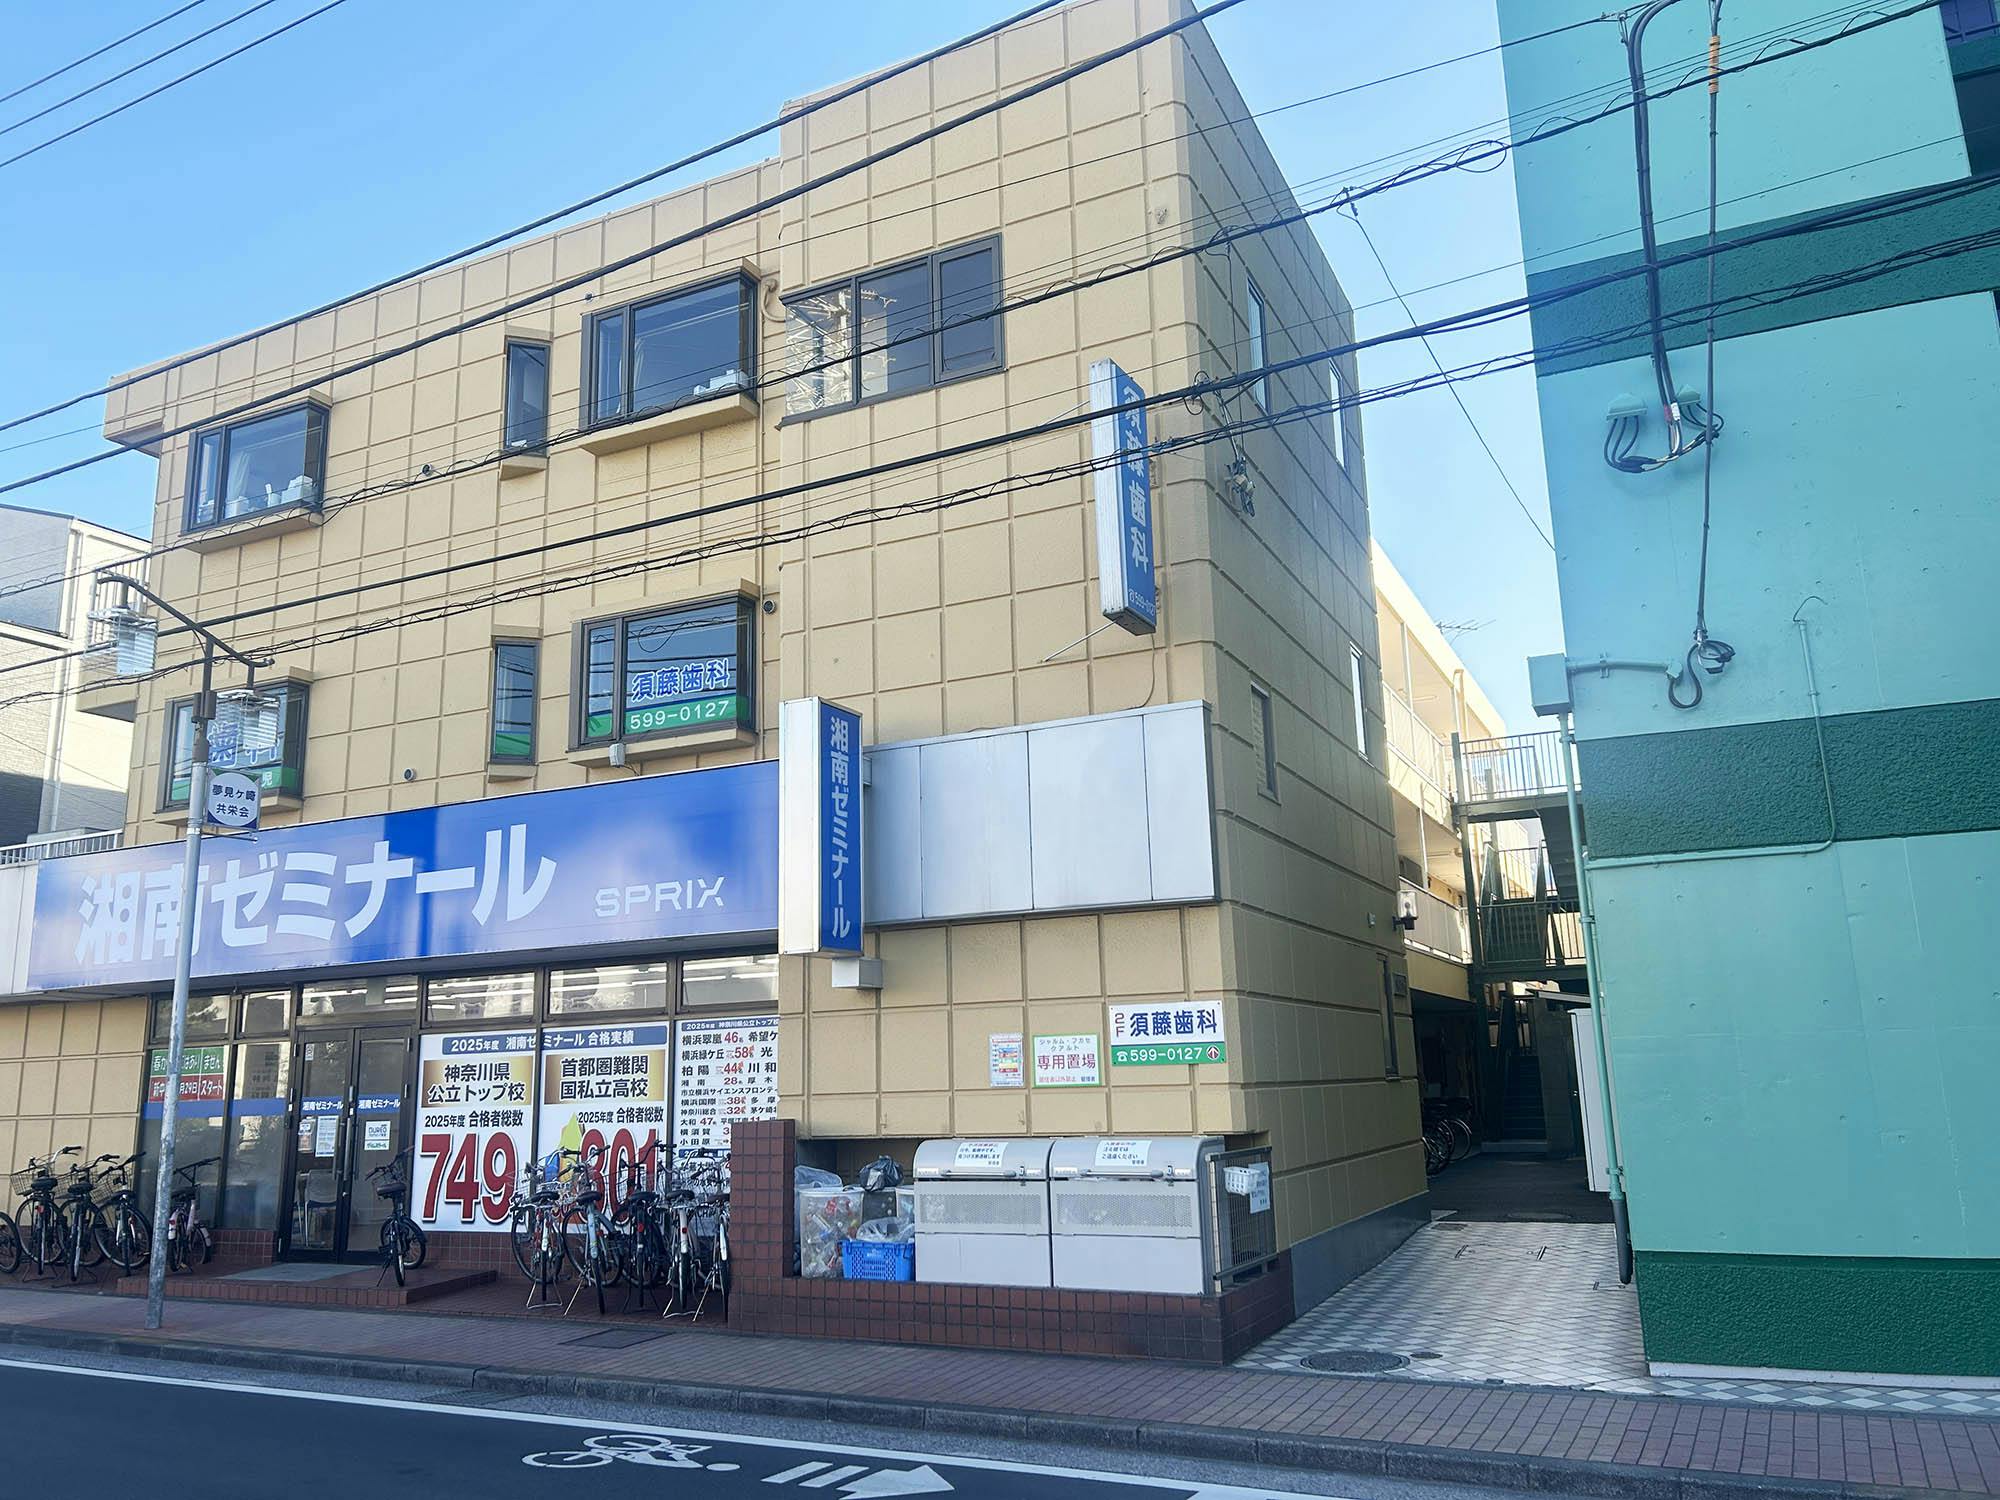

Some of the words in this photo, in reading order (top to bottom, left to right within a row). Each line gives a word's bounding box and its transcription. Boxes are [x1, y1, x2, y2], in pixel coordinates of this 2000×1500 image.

[631, 658, 730, 703] 須藤歯科
[630, 700, 729, 730] 599-0127
[216, 803, 250, 818] 共栄会
[830, 715, 851, 939] 湘南ゼミナール
[75, 823, 557, 965] 湘南ゼミナール
[594, 876, 725, 919] SPRIX
[1115, 1013, 1125, 1037] 2F
[1130, 1009, 1217, 1037] 須藤歯科
[451, 1040, 499, 1052] 2025年度
[588, 1030, 634, 1046] 合格実績
[682, 1034, 722, 1045] 横浜翠嵐
[761, 1046, 773, 1058] 光
[1037, 1053, 1096, 1070] 専用置場
[1130, 1048, 1203, 1061] 599-0127
[444, 1063, 511, 1083] 神奈川県
[561, 1056, 649, 1077] 首都圏難関
[428, 1083, 525, 1103] 公立トップ校
[560, 1078, 648, 1100] 国私立高校
[302, 1100, 344, 1111] 湘南ゼミナール
[359, 1099, 401, 1109] 湘南ゼミナール
[425, 1115, 466, 1128] 2025年度
[468, 1110, 524, 1127] 合格者総数
[578, 1111, 614, 1124] 2025年度
[616, 1106, 664, 1123] 合格者総数
[680, 1138, 711, 1146] 小田原
[420, 1131, 518, 1222] 749
